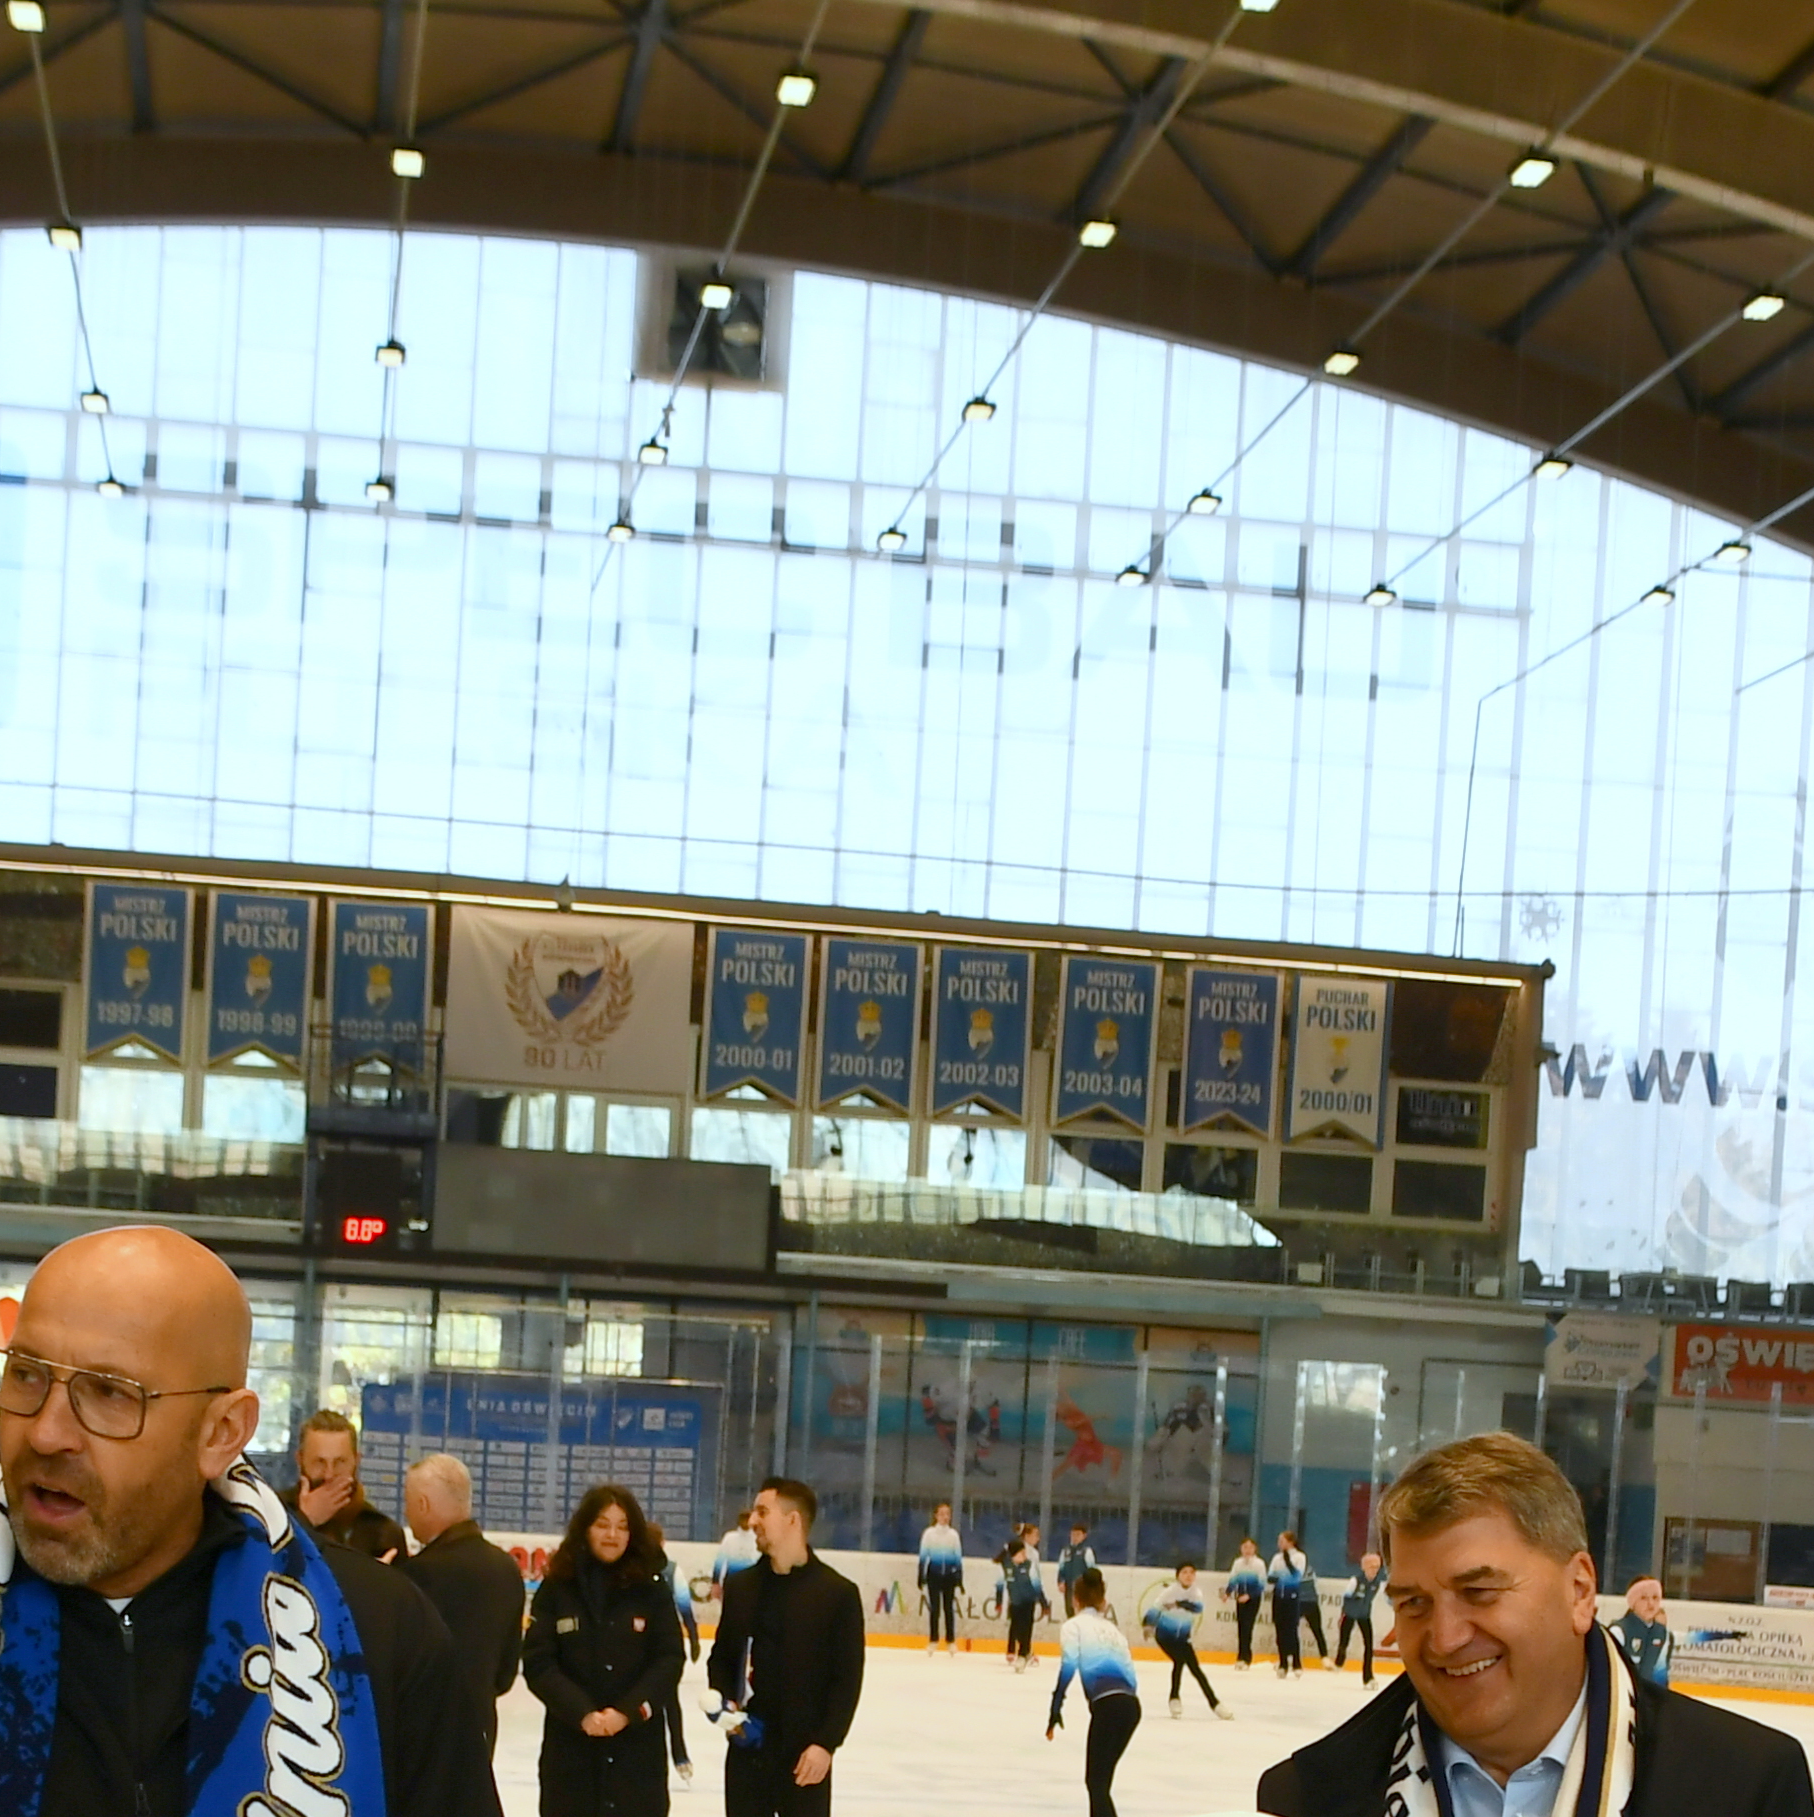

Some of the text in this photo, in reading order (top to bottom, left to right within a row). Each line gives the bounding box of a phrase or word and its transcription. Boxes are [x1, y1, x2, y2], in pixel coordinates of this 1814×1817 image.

[114, 897, 165, 912] MISTRZ
[238, 905, 288, 923] MISTRZ
[101, 914, 177, 942] POLSKI
[356, 914, 406, 931] MISTRZ
[223, 923, 299, 950] POLSKI
[343, 931, 418, 959] POLSKI
[735, 942, 785, 959] MISTRZ
[847, 951, 897, 969] MISTRZ
[722, 959, 795, 988] POLSKI
[960, 960, 1008, 976] MISTRZ
[1087, 970, 1135, 989] MISTRZ
[835, 968, 907, 996] POLSKI
[947, 976, 1019, 1004] POLSKI
[1211, 982, 1258, 999] MISTRZ
[1074, 989, 1145, 1015] POLSKI
[1316, 989, 1369, 1006] PUCHAR
[1199, 998, 1267, 1024] POLSKI
[1306, 1005, 1376, 1032] POLSKI
[715, 1044, 792, 1071] 2000-01
[829, 1053, 905, 1080] 2001-02
[939, 1061, 1019, 1088] 2002-03
[1064, 1071, 1142, 1098] 2003-04
[1194, 1080, 1261, 1105] 2023-24
[1300, 1090, 1372, 1115] 2000/01
